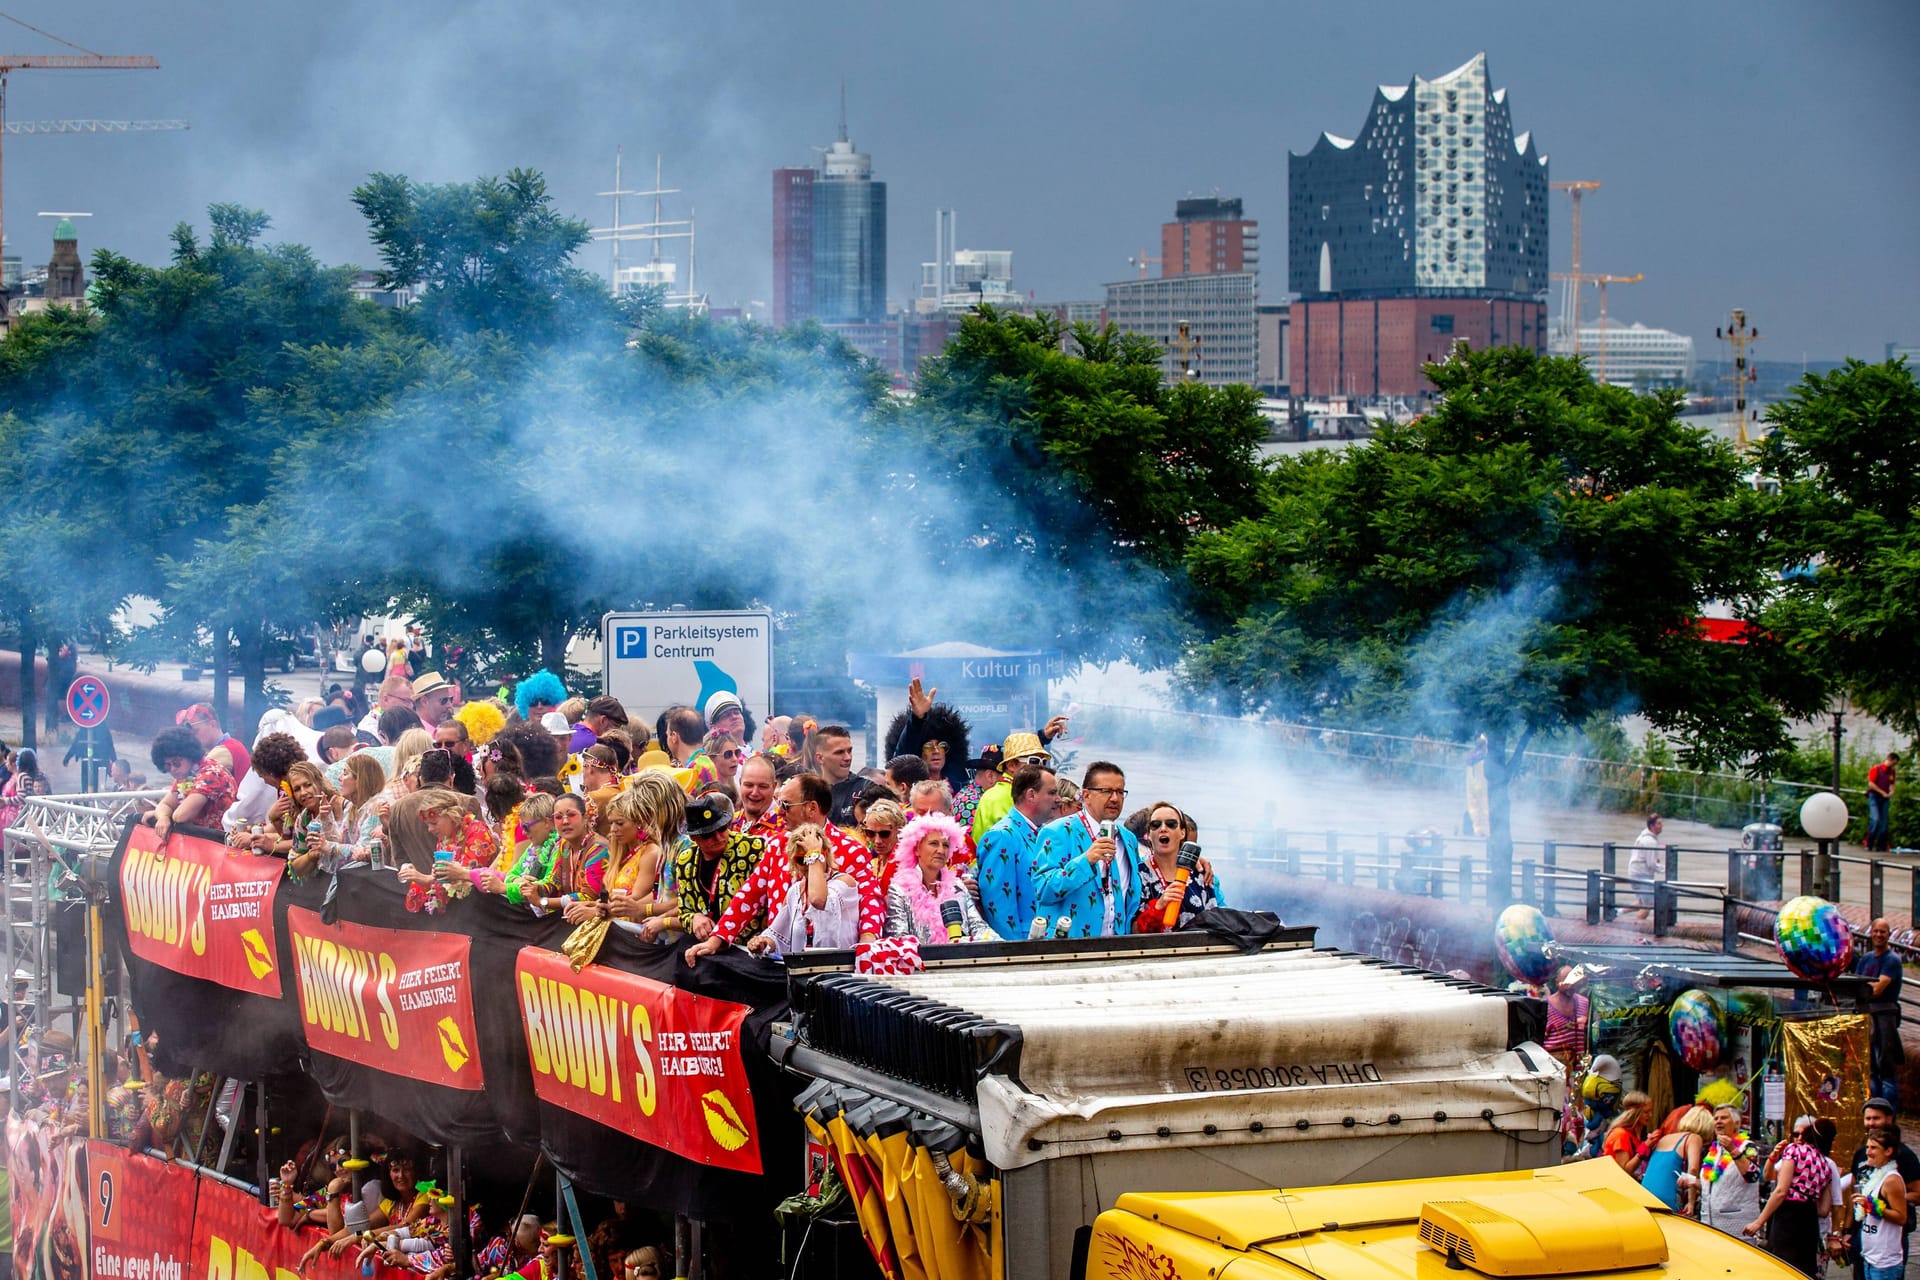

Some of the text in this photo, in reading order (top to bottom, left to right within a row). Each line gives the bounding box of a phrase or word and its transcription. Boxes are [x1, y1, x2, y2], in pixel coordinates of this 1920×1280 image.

[622, 625, 759, 656] P Parkleitsystem
[654, 644, 715, 658] Centrum
[961, 660, 1020, 679] Kultur
[1028, 659, 1041, 677] in
[957, 704, 1008, 714] KNOPFLER
[122, 848, 211, 957] BUDDY'S
[210, 880, 273, 901] HIER FEIERT
[210, 901, 261, 921] HAMBURG!
[398, 961, 463, 990] HIER FEIERT
[293, 931, 400, 1051] BUDDY'S
[399, 985, 457, 1012] HAMBURG!
[519, 970, 657, 1117] BUDDY'S
[1215, 1064, 1308, 1090] 300058
[1309, 1062, 1383, 1085] DHLA
[99, 1170, 114, 1228] 9
[95, 1245, 121, 1278] Eine
[123, 1256, 151, 1280] neue
[152, 1251, 182, 1280] Party
